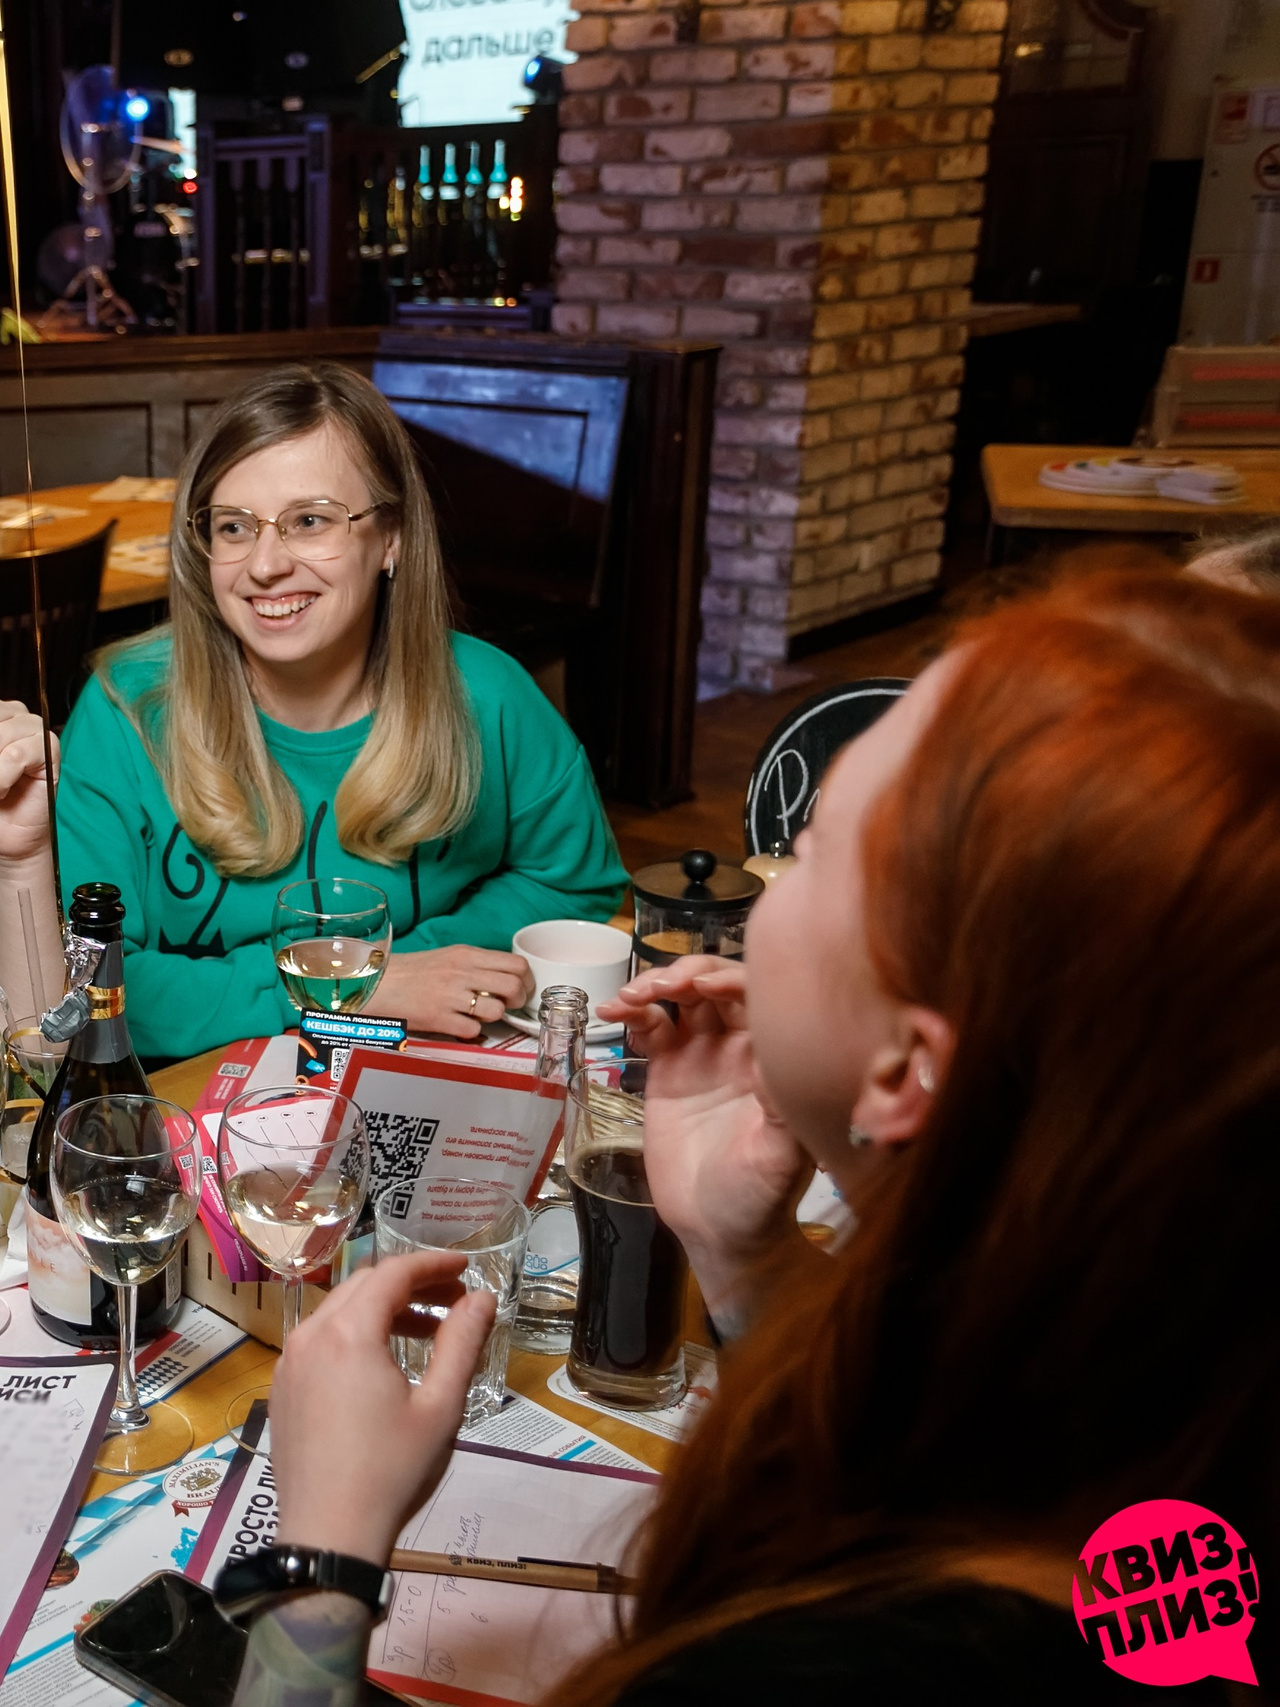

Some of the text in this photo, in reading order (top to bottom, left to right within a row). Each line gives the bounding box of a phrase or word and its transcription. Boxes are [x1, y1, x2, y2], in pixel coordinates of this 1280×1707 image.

[423, 30, 554, 64] дальше
[306, 1011, 401, 1027] ПРОГРАММА ЛОЯЛЬНОСТИ
[306, 1020, 401, 1038] КЕШБЭК ДО 20%
[458, 1138, 492, 1148] запомните
[463, 1152, 495, 1161] присвоен
[3, 1374, 77, 1389] ЛИСТ
[168, 1461, 220, 1489] MAXIMILIAN'S
[187, 1484, 221, 1498] BRAU
[466, 1556, 527, 1571] КВИЗ, ПЛИЗ!
